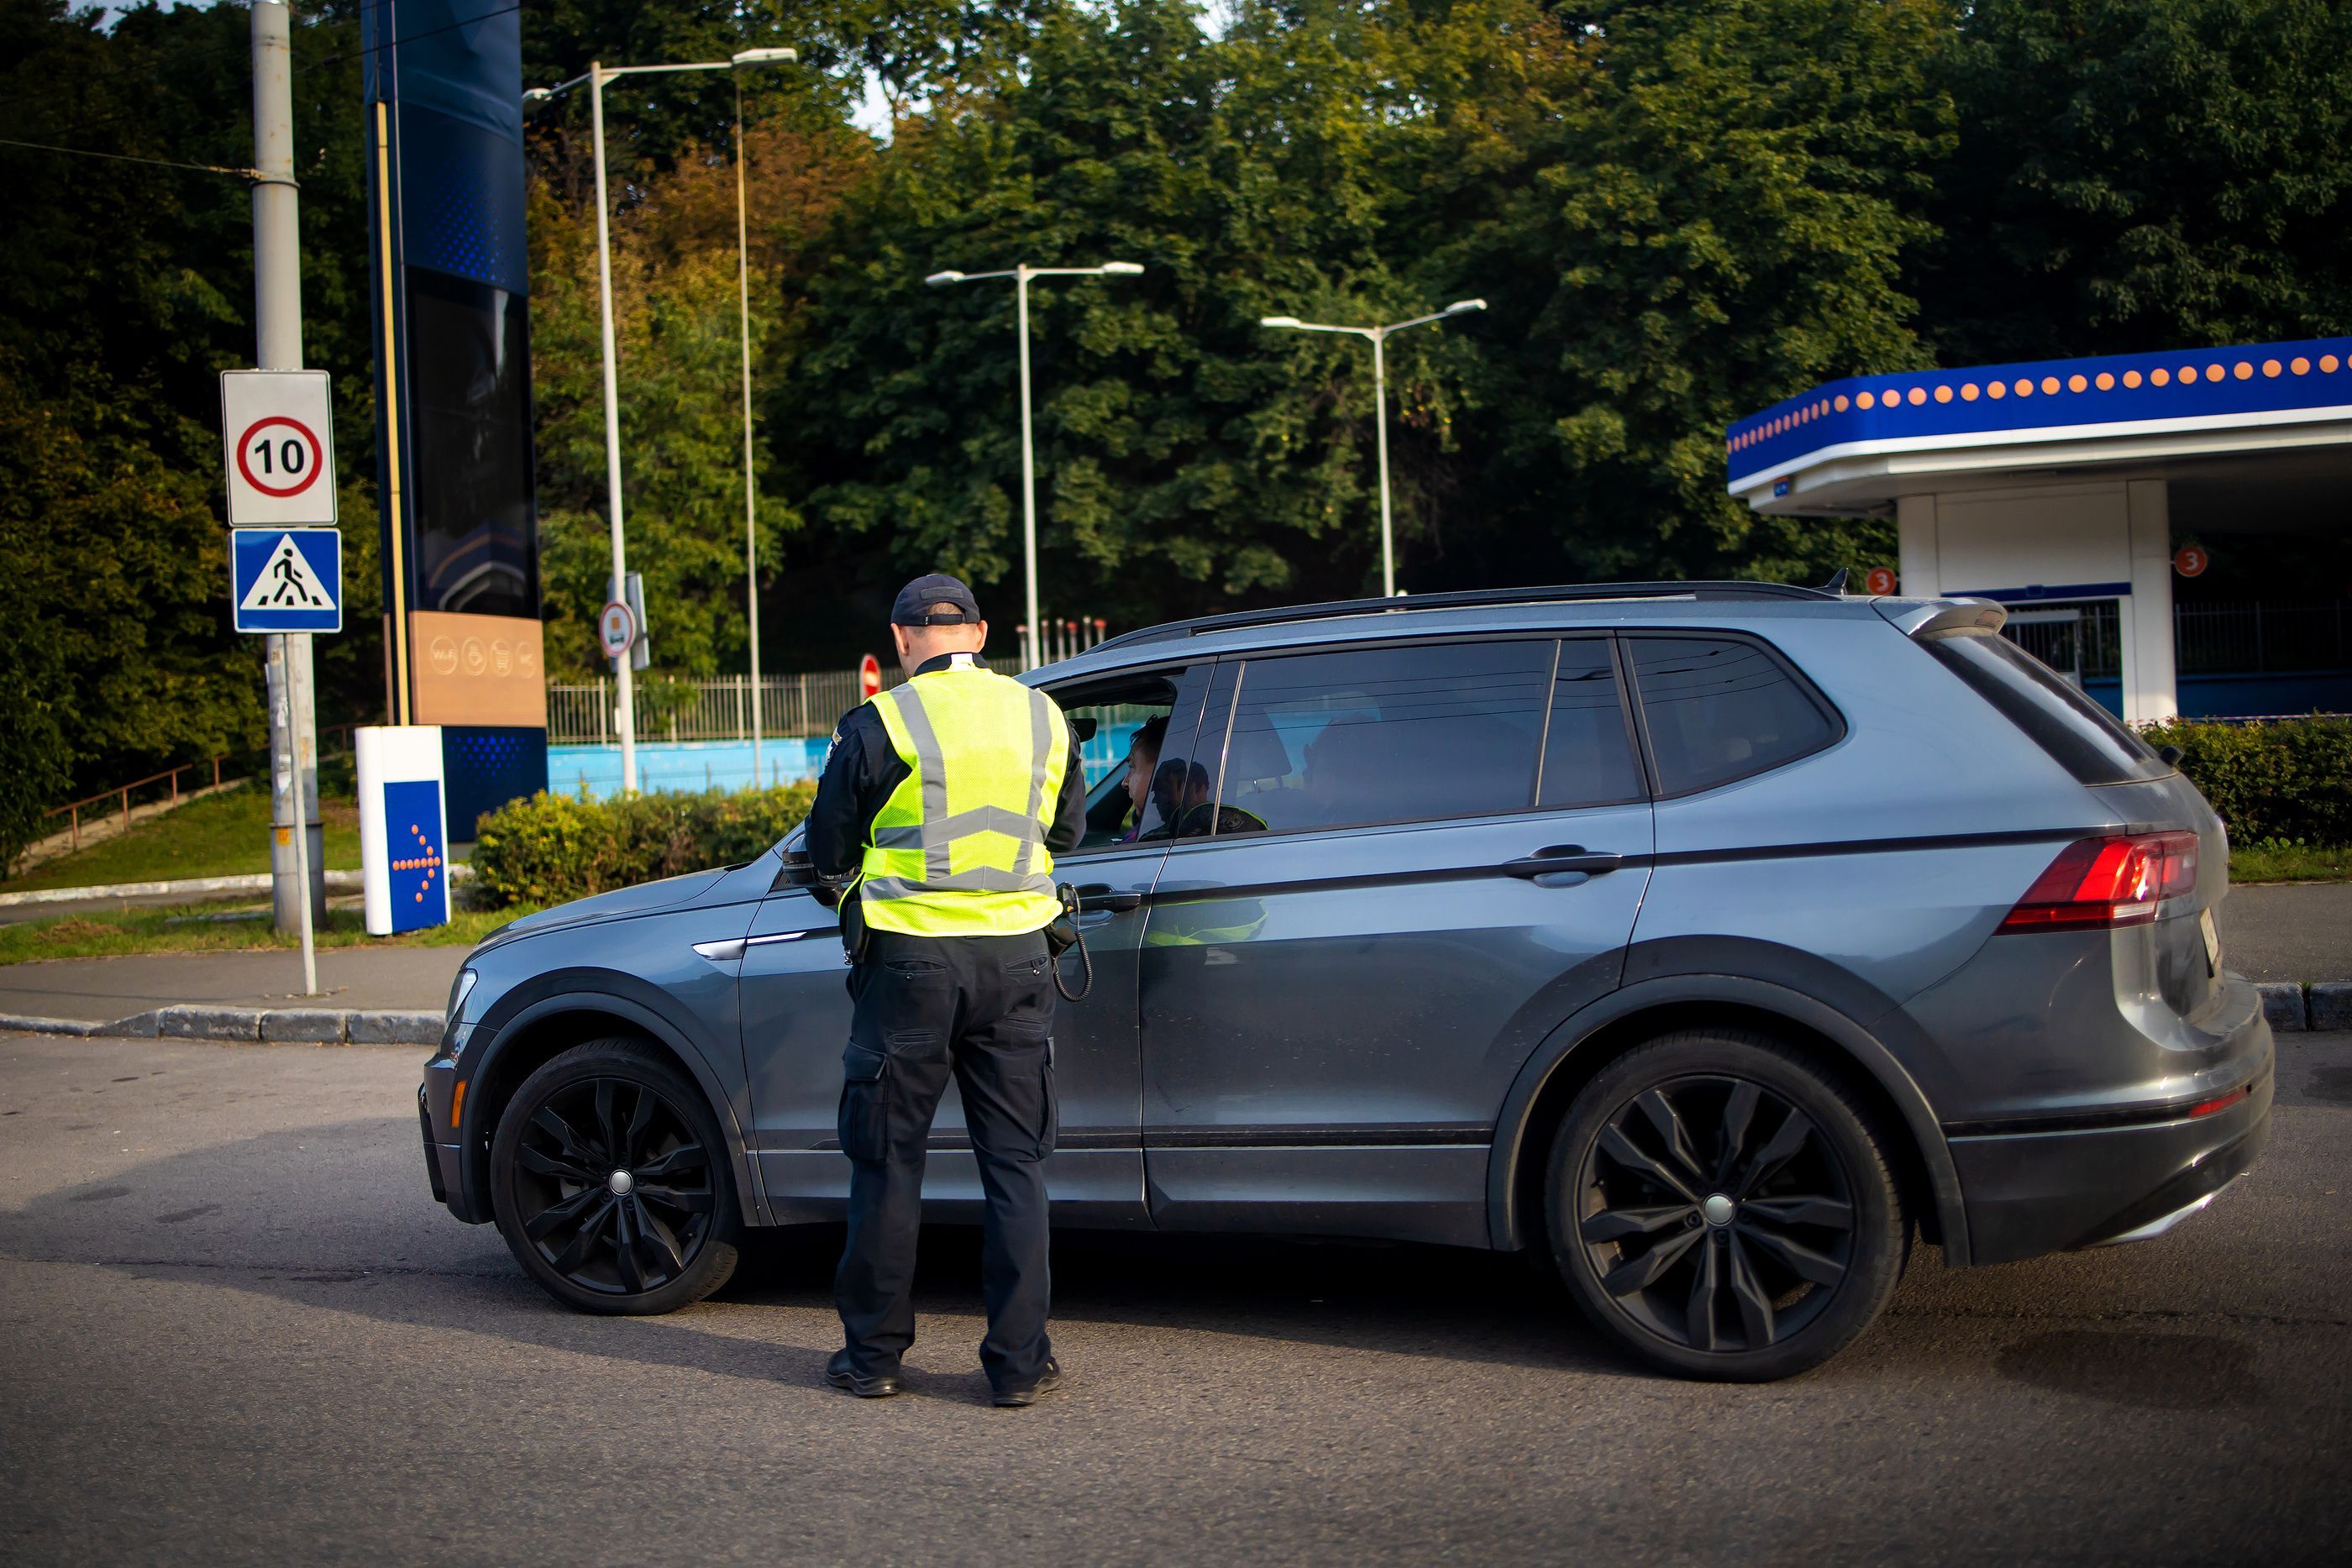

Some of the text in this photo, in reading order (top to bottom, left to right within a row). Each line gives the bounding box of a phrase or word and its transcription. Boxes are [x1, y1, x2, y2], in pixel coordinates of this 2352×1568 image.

[255, 439, 304, 475] 10
[2185, 552, 2198, 570] 3
[1876, 573, 1888, 591] 3
